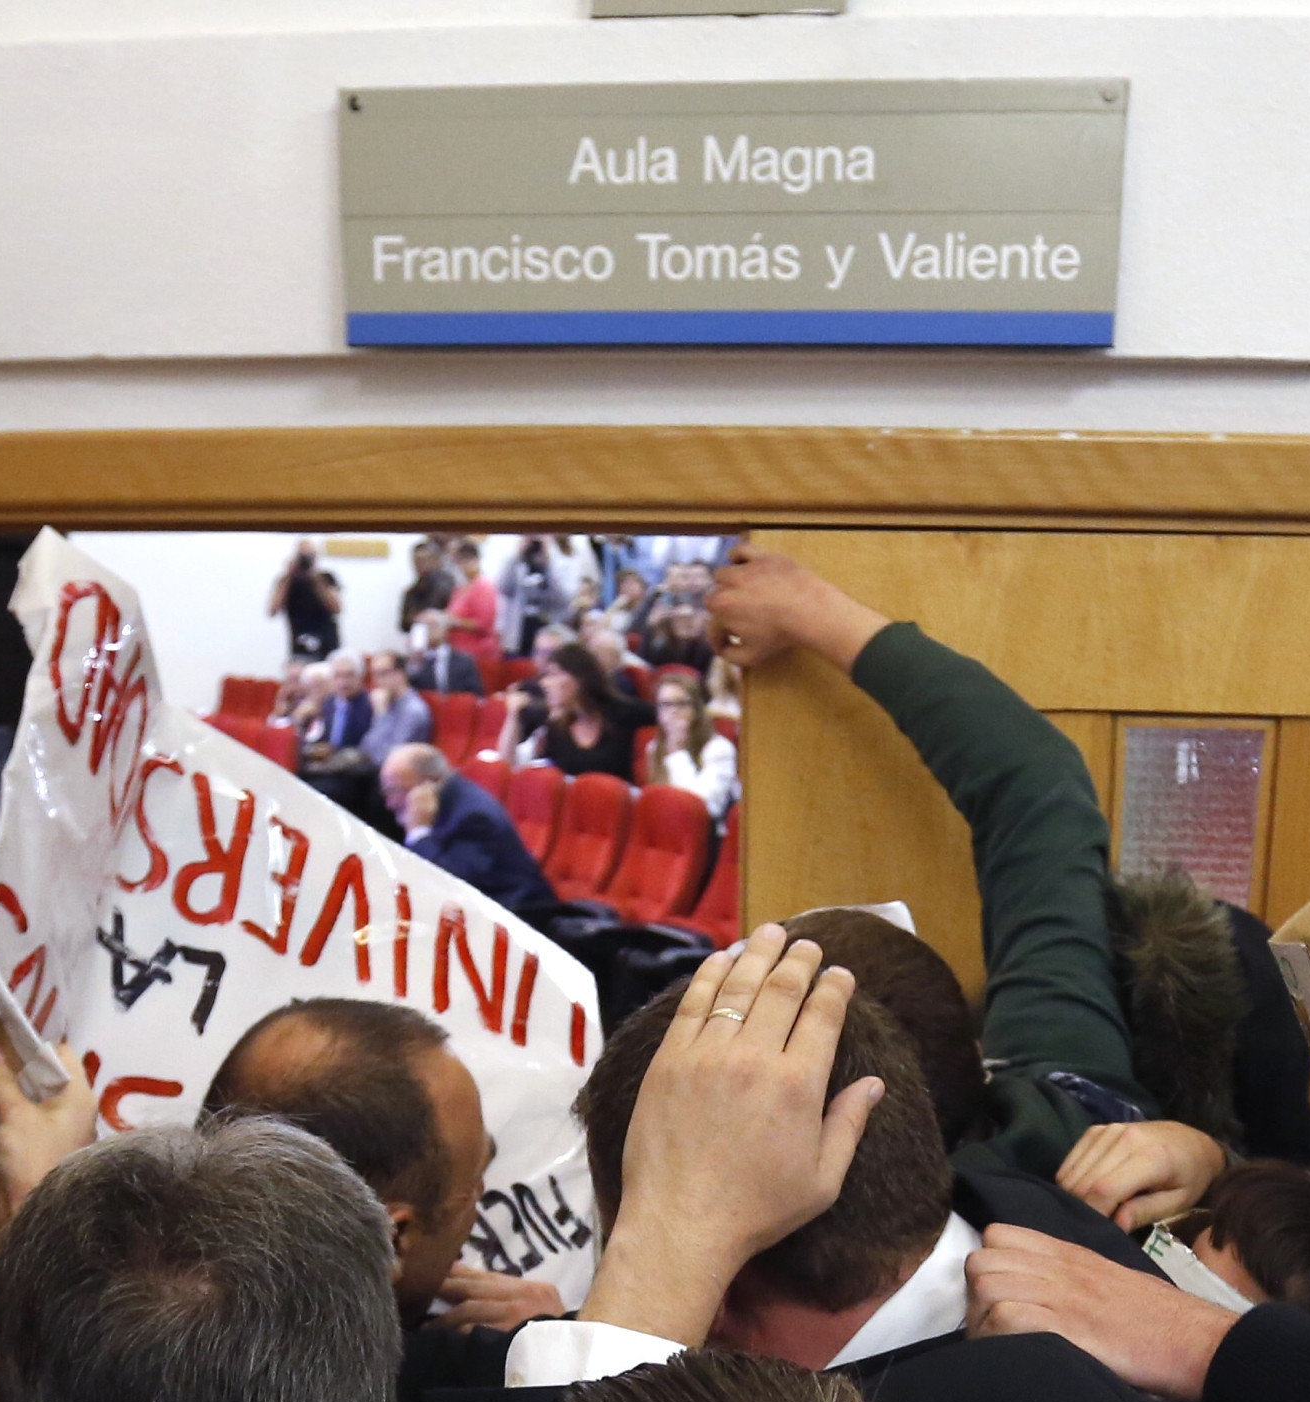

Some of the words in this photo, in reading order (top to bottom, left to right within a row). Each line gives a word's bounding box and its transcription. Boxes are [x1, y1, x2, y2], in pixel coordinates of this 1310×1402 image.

[568, 136, 679, 186] Aula
[703, 134, 876, 196] Magna
[372, 235, 616, 284] Francisco
[636, 233, 803, 283] Tomás
[824, 244, 857, 292] y
[879, 233, 1082, 283] Valiente
[96, 905, 226, 1035] LA
[460, 1175, 592, 1278] FUER
